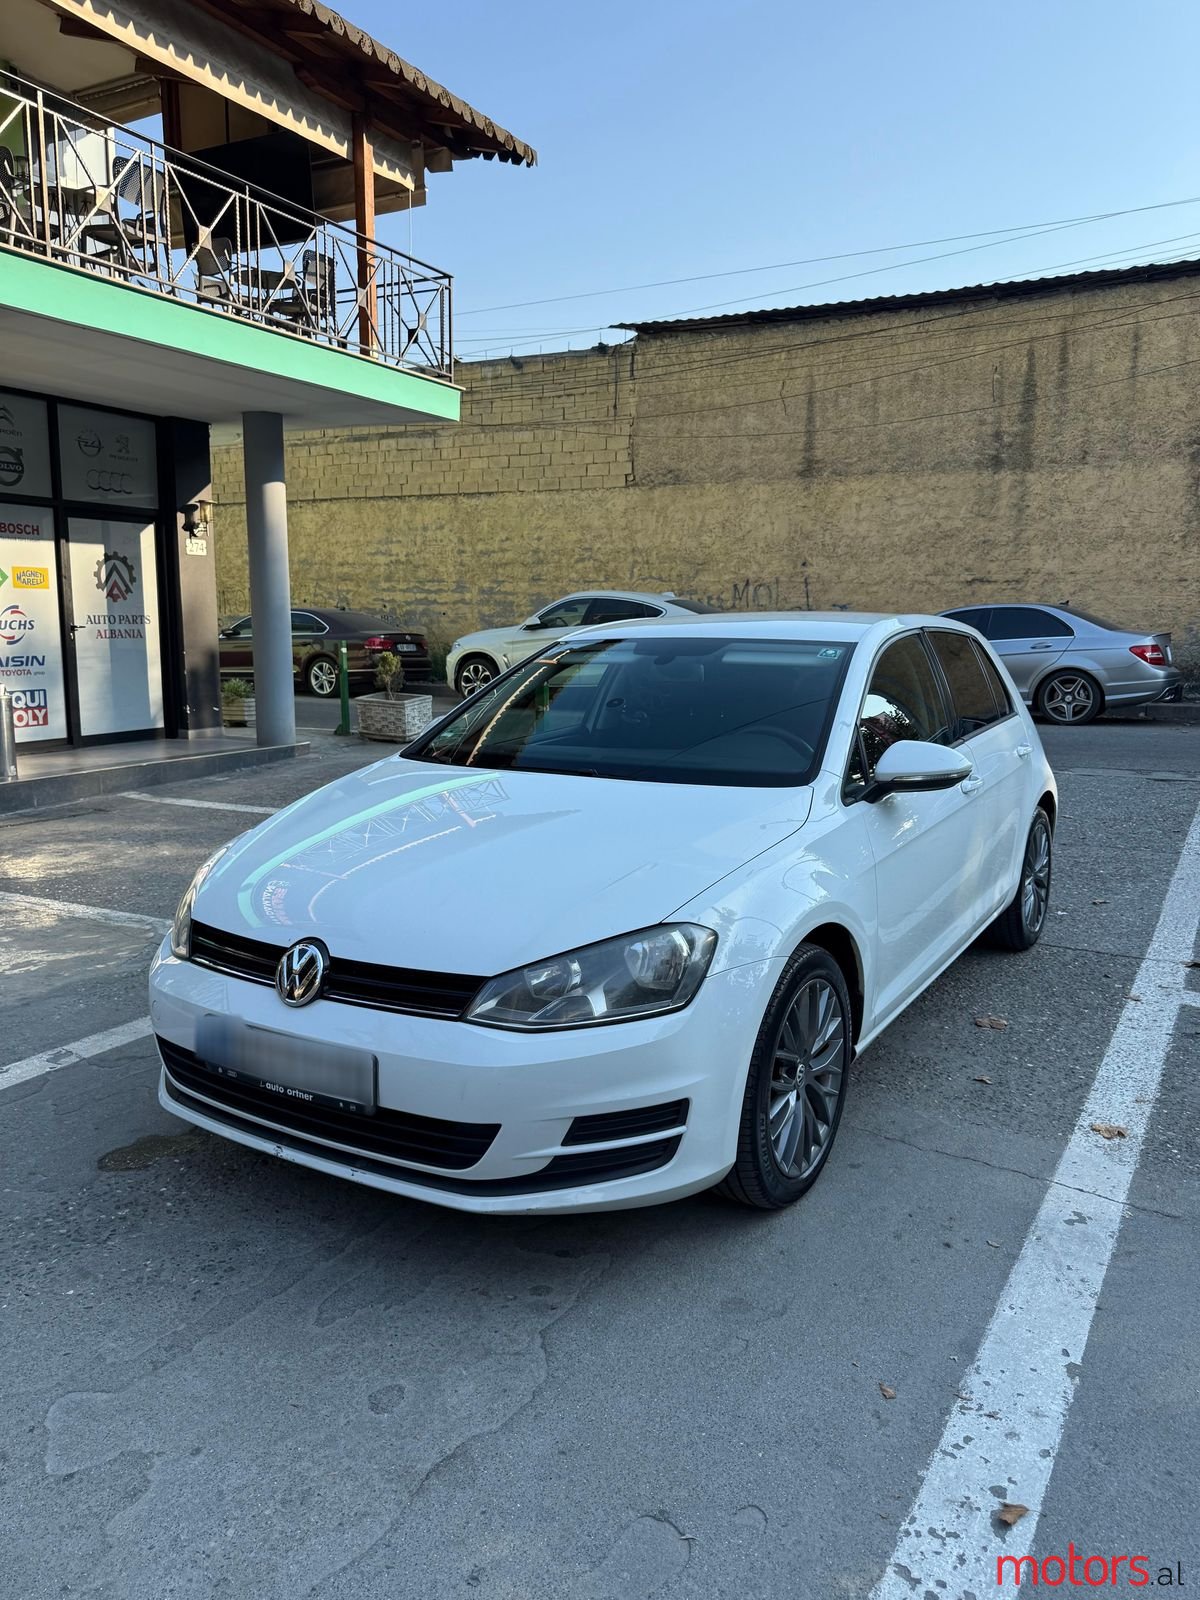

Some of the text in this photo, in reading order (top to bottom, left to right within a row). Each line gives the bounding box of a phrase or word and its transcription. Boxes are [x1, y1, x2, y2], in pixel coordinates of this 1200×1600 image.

[0, 463, 22, 472] OLVO
[0, 522, 40, 536] BOSCH
[0, 619, 35, 631] UCHS
[86, 614, 151, 625] AUTO PARTS
[96, 628, 144, 640] ALBANIA
[1, 668, 32, 677] TOYOTA
[11, 690, 45, 709] QUI
[13, 708, 47, 727] OLY
[265, 1082, 314, 1102] auto ortner
